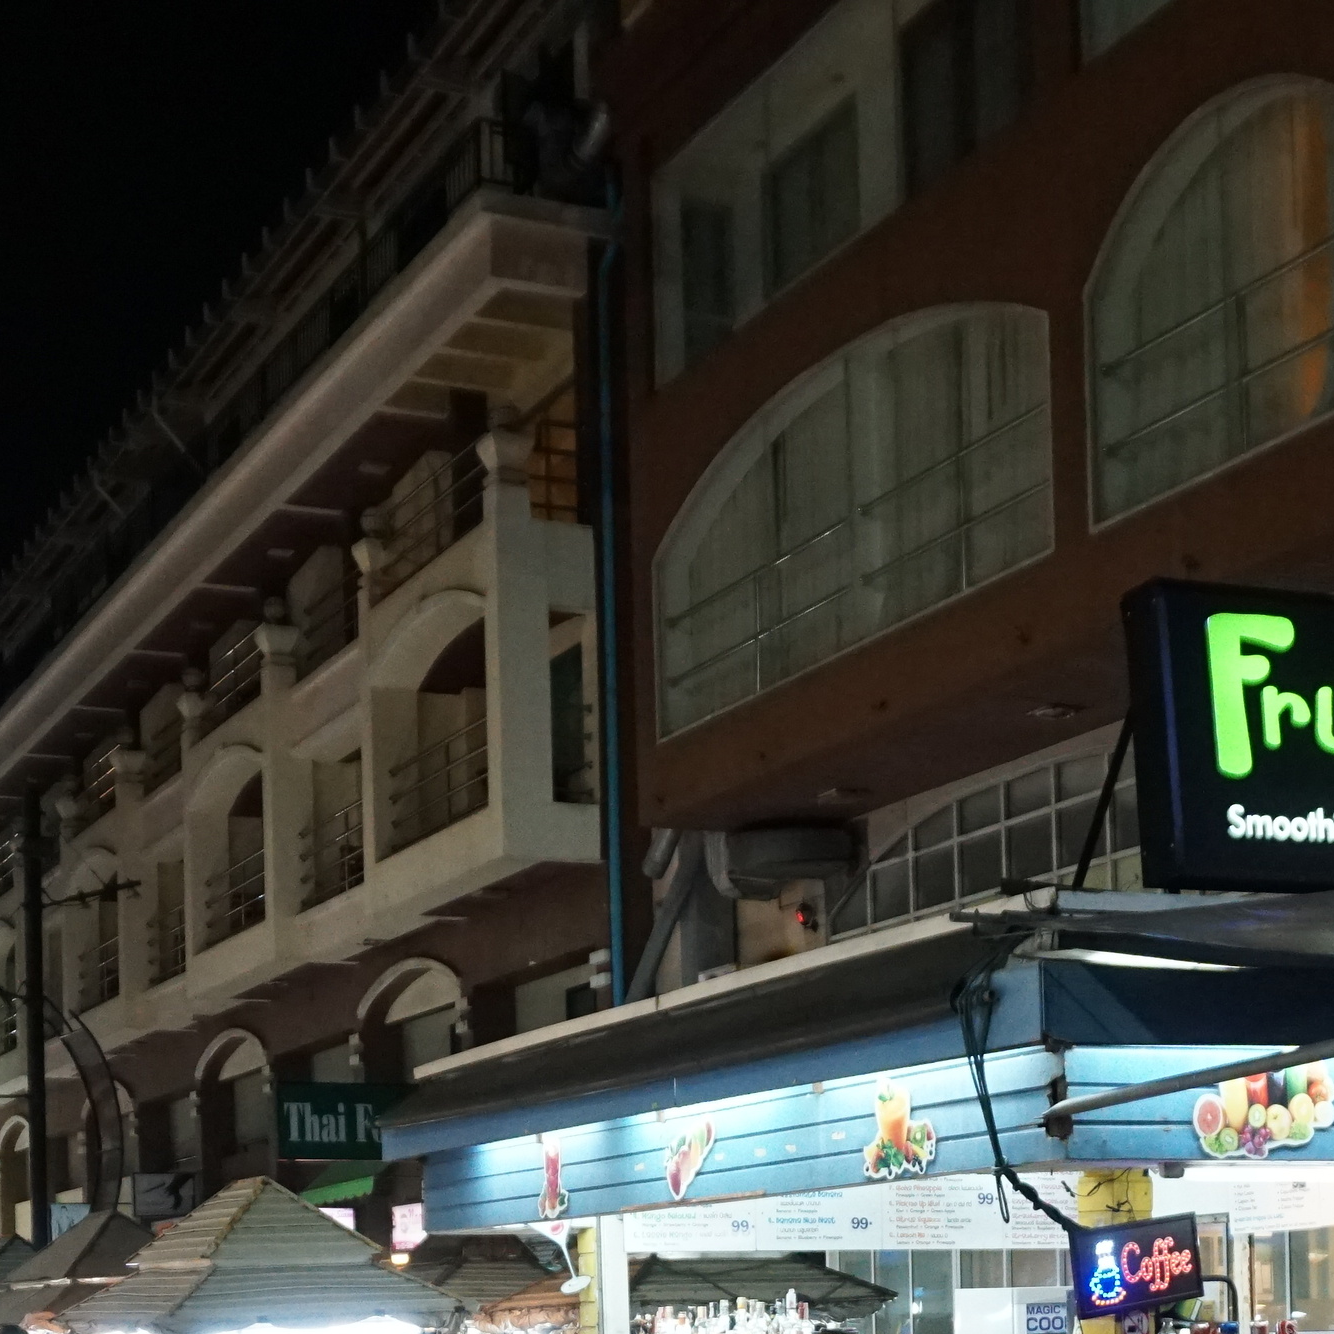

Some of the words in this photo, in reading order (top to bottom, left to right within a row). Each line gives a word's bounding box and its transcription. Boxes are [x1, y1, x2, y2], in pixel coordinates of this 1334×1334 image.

[284, 1102, 347, 1142] Thai
[1121, 1236, 1193, 1292] Coffee
[1027, 1304, 1061, 1315] MAGIC
